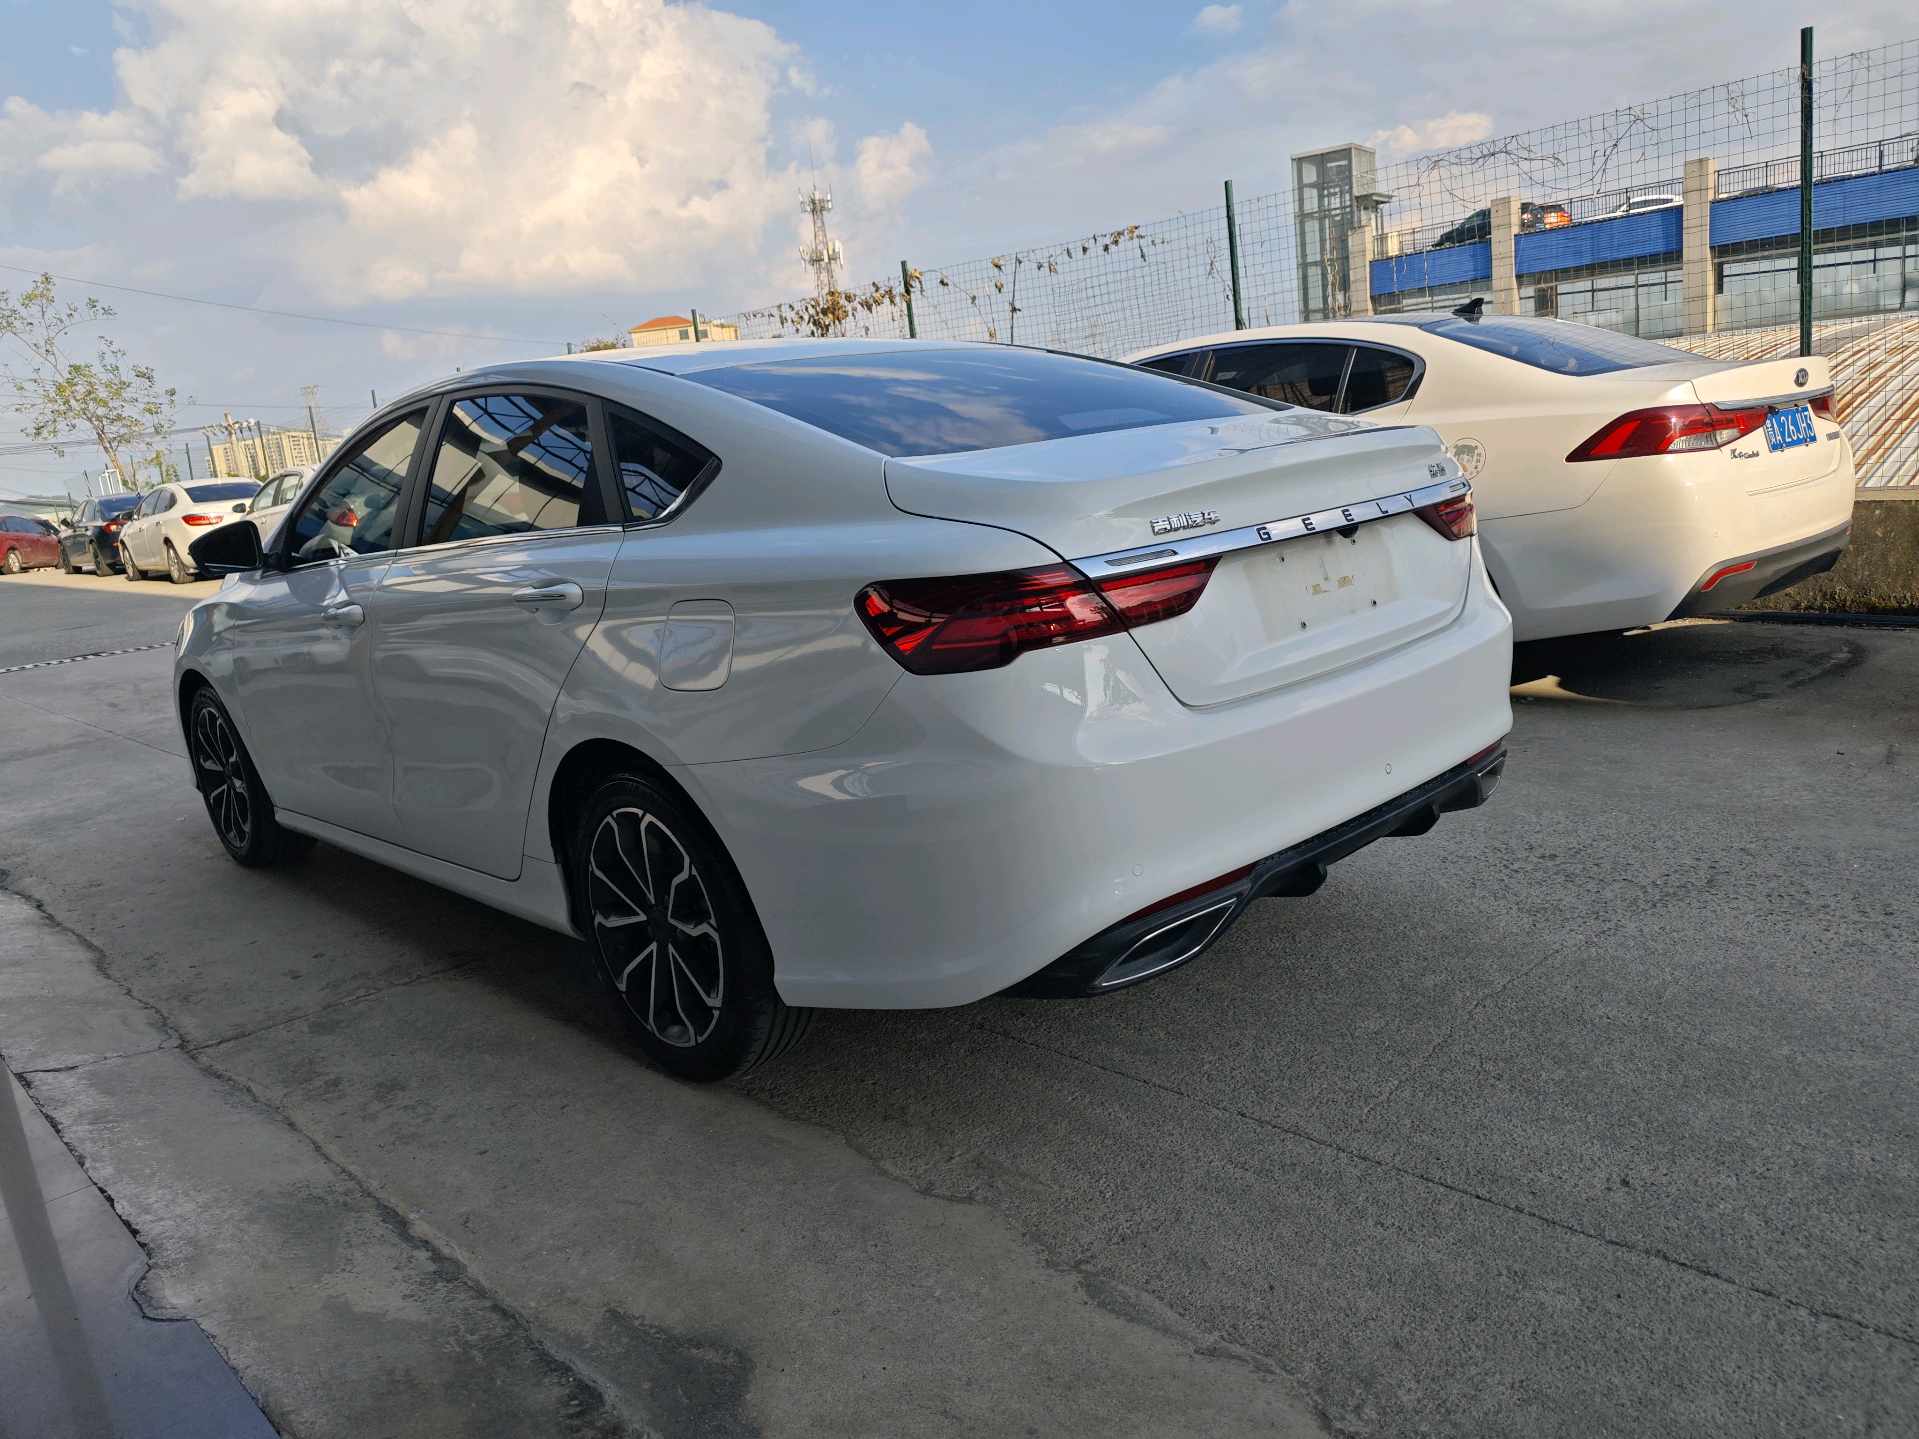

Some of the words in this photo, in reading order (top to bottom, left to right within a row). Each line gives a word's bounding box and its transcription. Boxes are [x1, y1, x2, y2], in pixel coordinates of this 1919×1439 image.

[1150, 509, 1221, 536] 吉利汽车
[1256, 494, 1415, 542] GEELY
